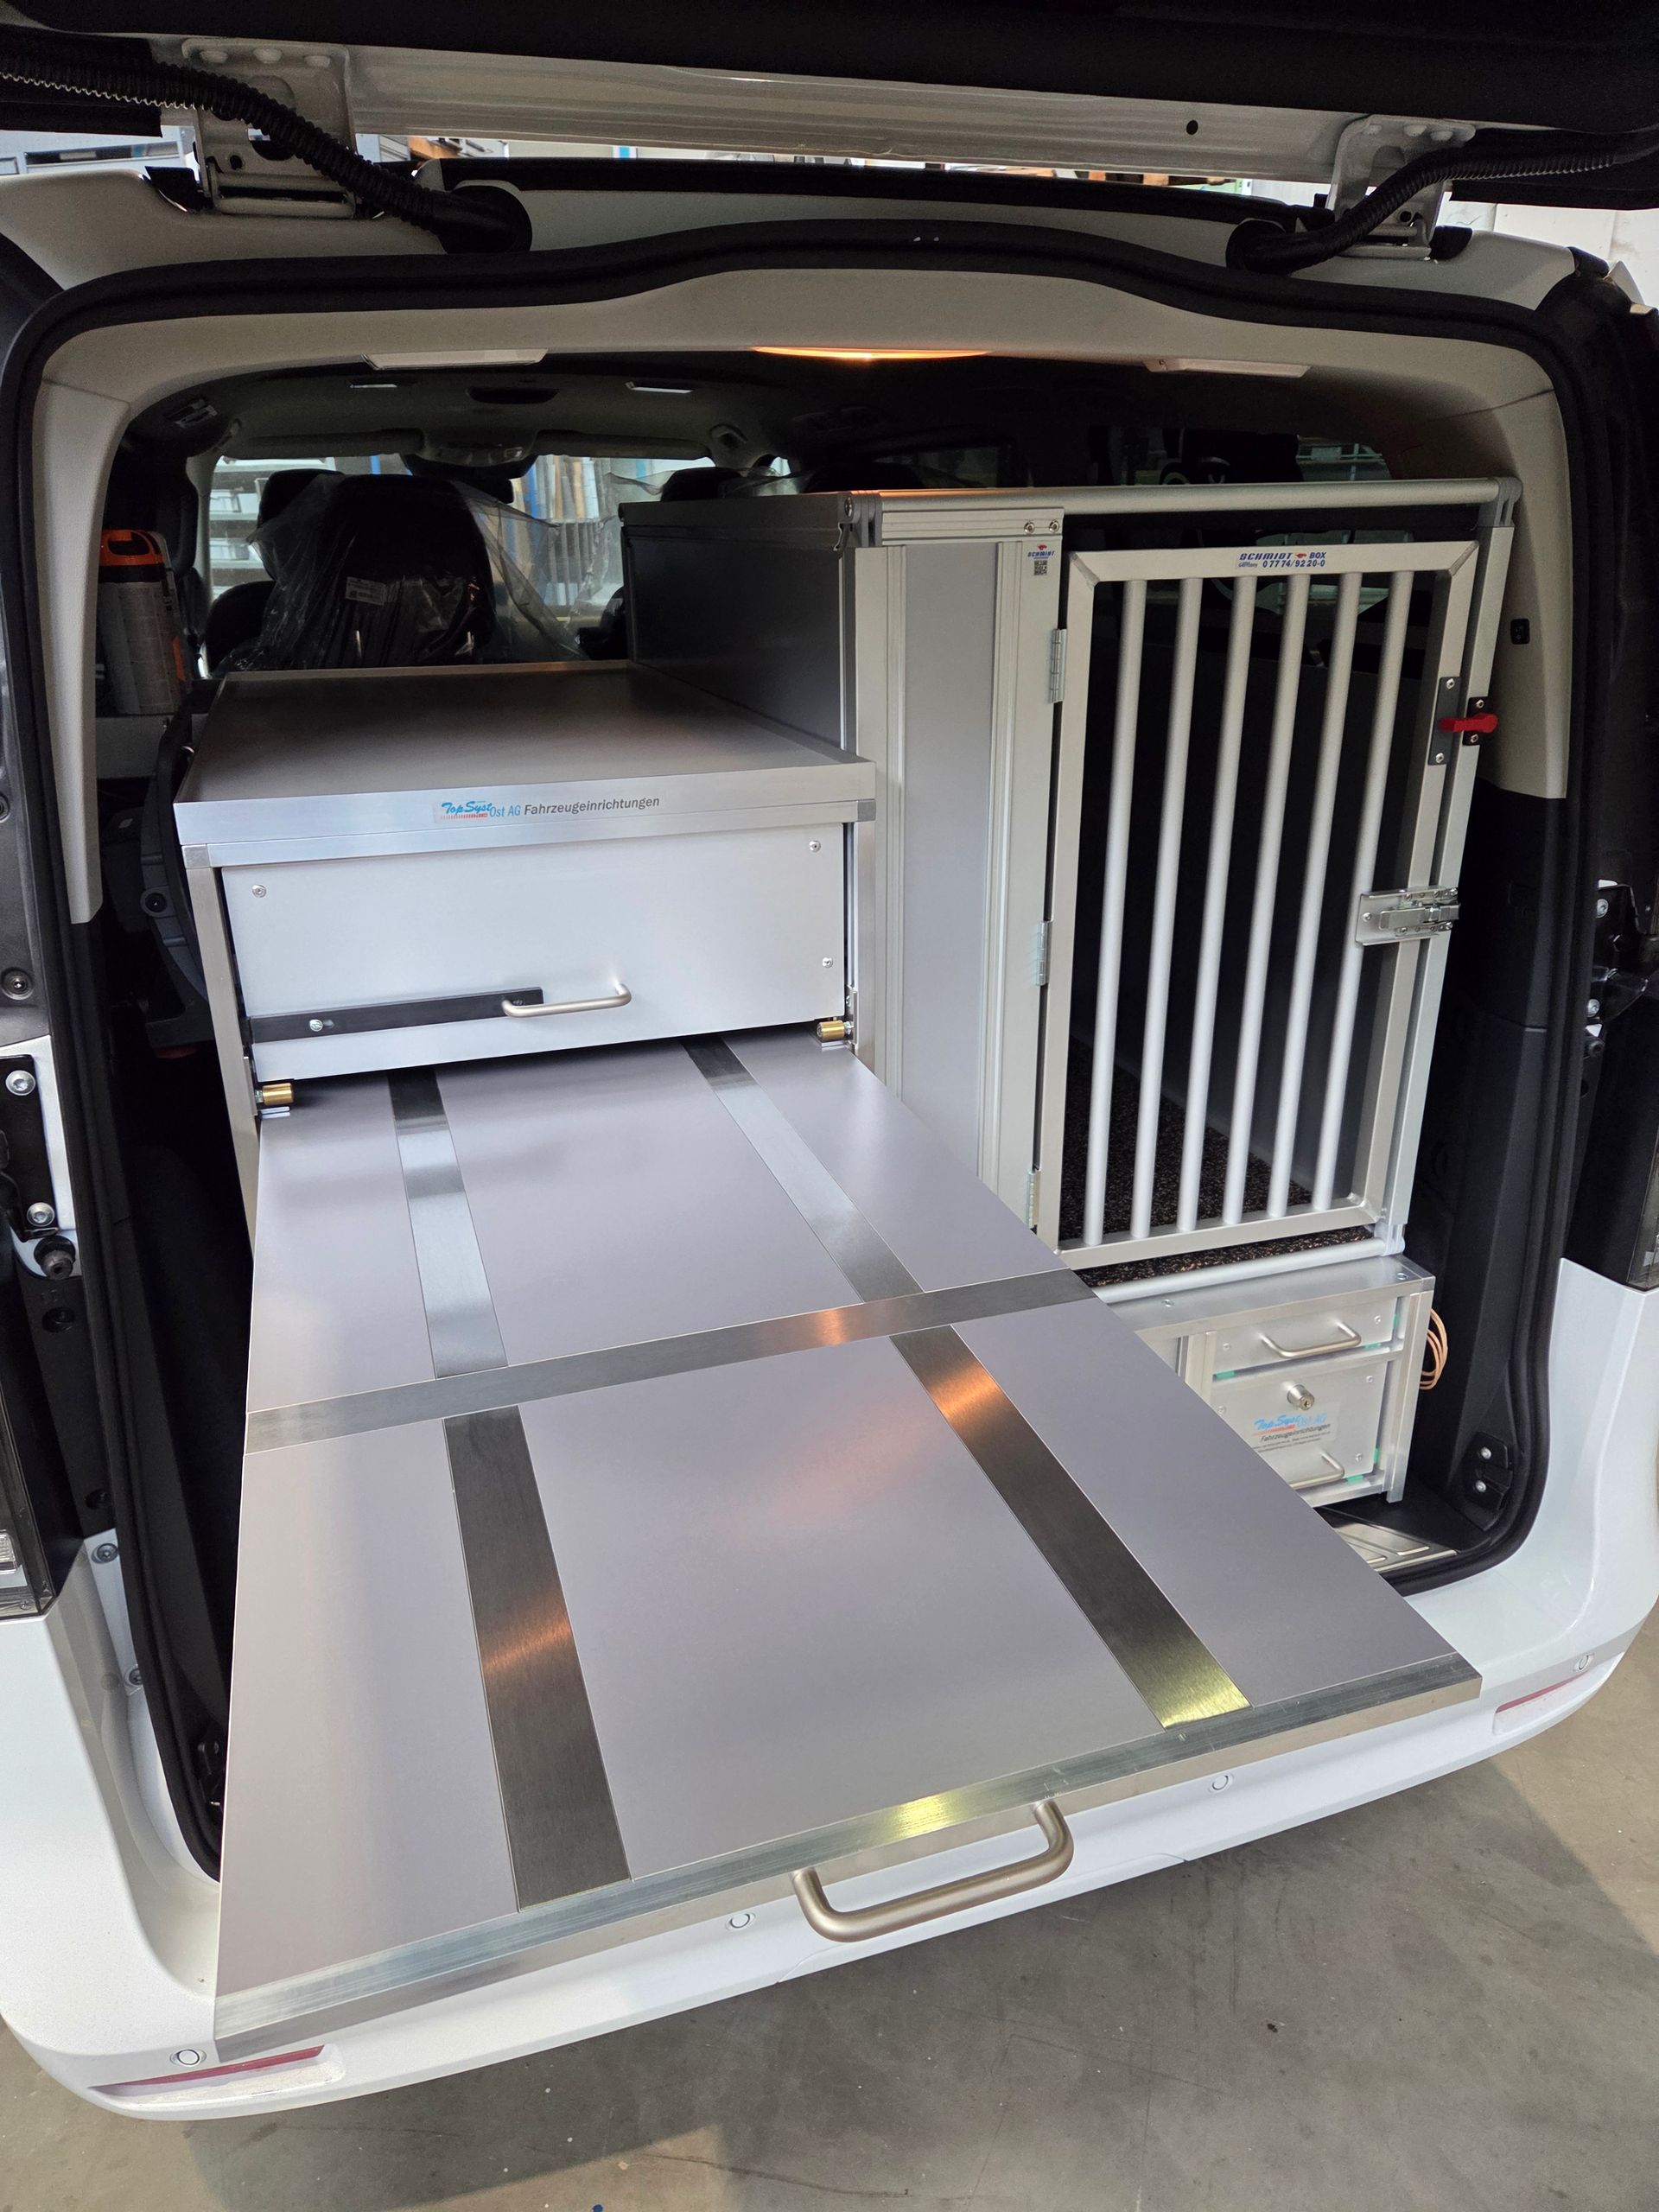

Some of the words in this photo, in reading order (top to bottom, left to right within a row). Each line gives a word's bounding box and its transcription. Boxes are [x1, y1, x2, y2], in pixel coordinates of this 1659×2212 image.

[1239, 552, 1294, 561] SCHMIDT
[490, 805, 506, 817] Ost
[507, 804, 522, 817] AG
[524, 798, 660, 815] Fahrzeugeinrichtungen
